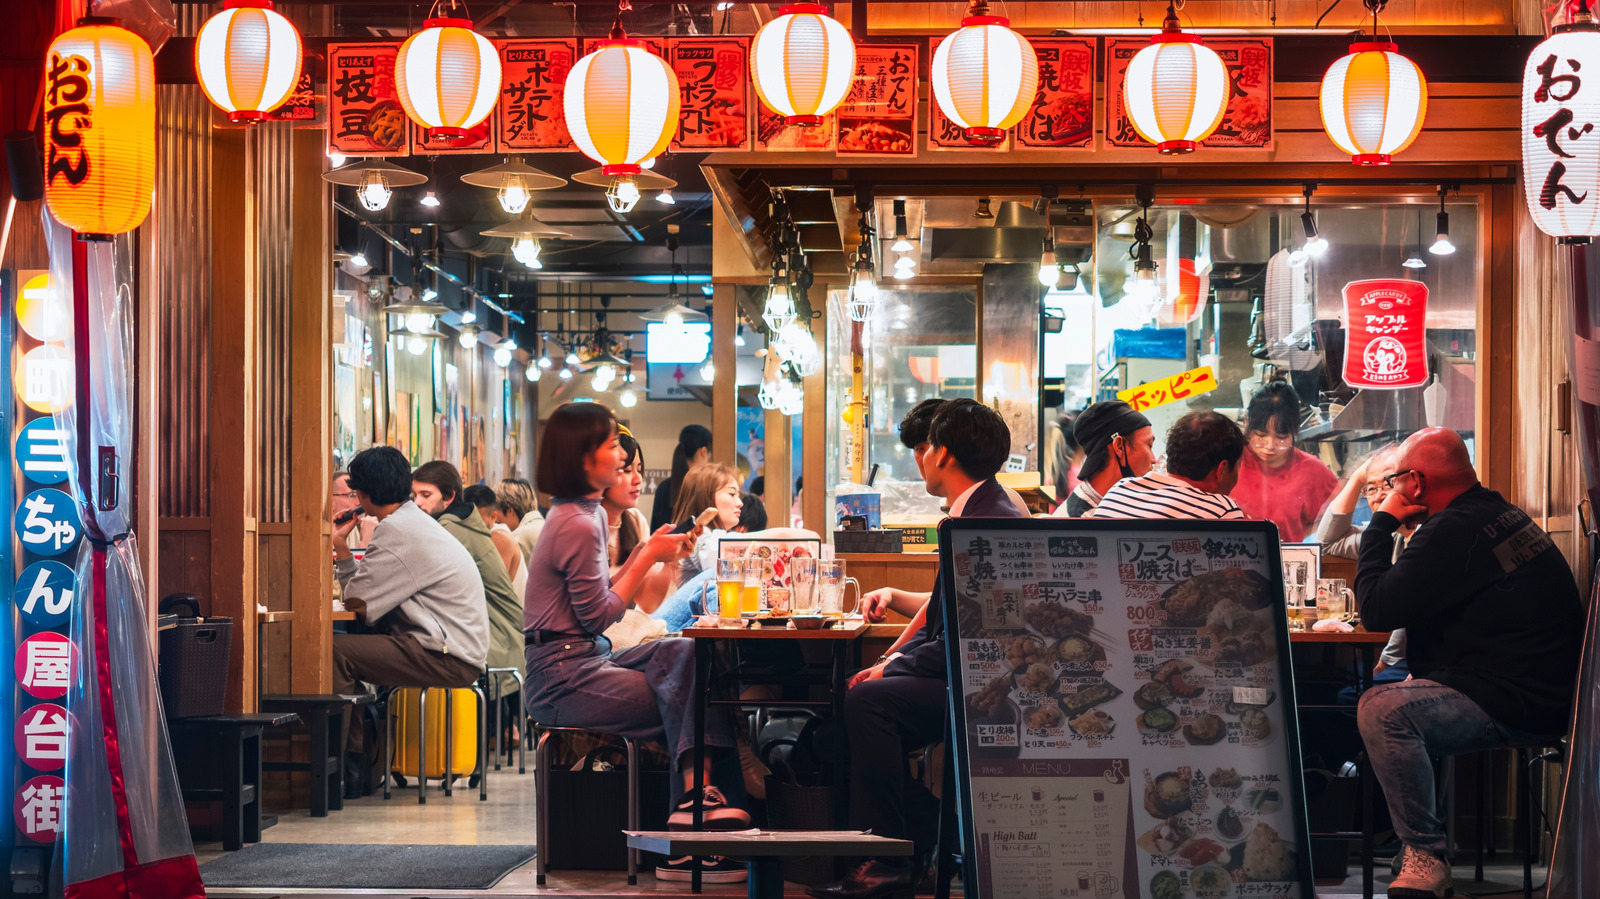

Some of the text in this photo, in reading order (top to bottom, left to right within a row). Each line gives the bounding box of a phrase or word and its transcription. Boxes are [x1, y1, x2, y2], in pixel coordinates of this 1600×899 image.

[340, 58, 373, 66] とりあえず
[508, 51, 545, 60] とりあえず
[887, 51, 911, 110] おでん
[524, 61, 553, 131] ポテト
[693, 61, 717, 134] フライド
[333, 69, 376, 138] 枝豆
[503, 82, 531, 141] サラダ
[680, 82, 700, 141] ポテト
[47, 53, 91, 188] おでん
[1533, 54, 1594, 211] おでん
[1365, 314, 1407, 324] アップル
[1128, 373, 1209, 412] ホッピー
[1123, 542, 1175, 562] ソース
[1052, 561, 1084, 569] しいたけ串
[1136, 558, 1197, 581] 焼そば
[1002, 571, 1028, 579] ねぎま串
[1053, 571, 1072, 579] ねぎ串
[1039, 587, 1102, 604] 牛ハラミ串
[1127, 605, 1167, 620] 800円
[1024, 740, 1046, 748] とり天
[1070, 733, 1115, 741] フライドポテト
[1022, 763, 1071, 775] MENU
[978, 791, 1023, 802] 生ビール
[993, 831, 1037, 842] High Ball
[1151, 859, 1173, 867] トマト
[1235, 882, 1294, 895] ポテトサラダ
